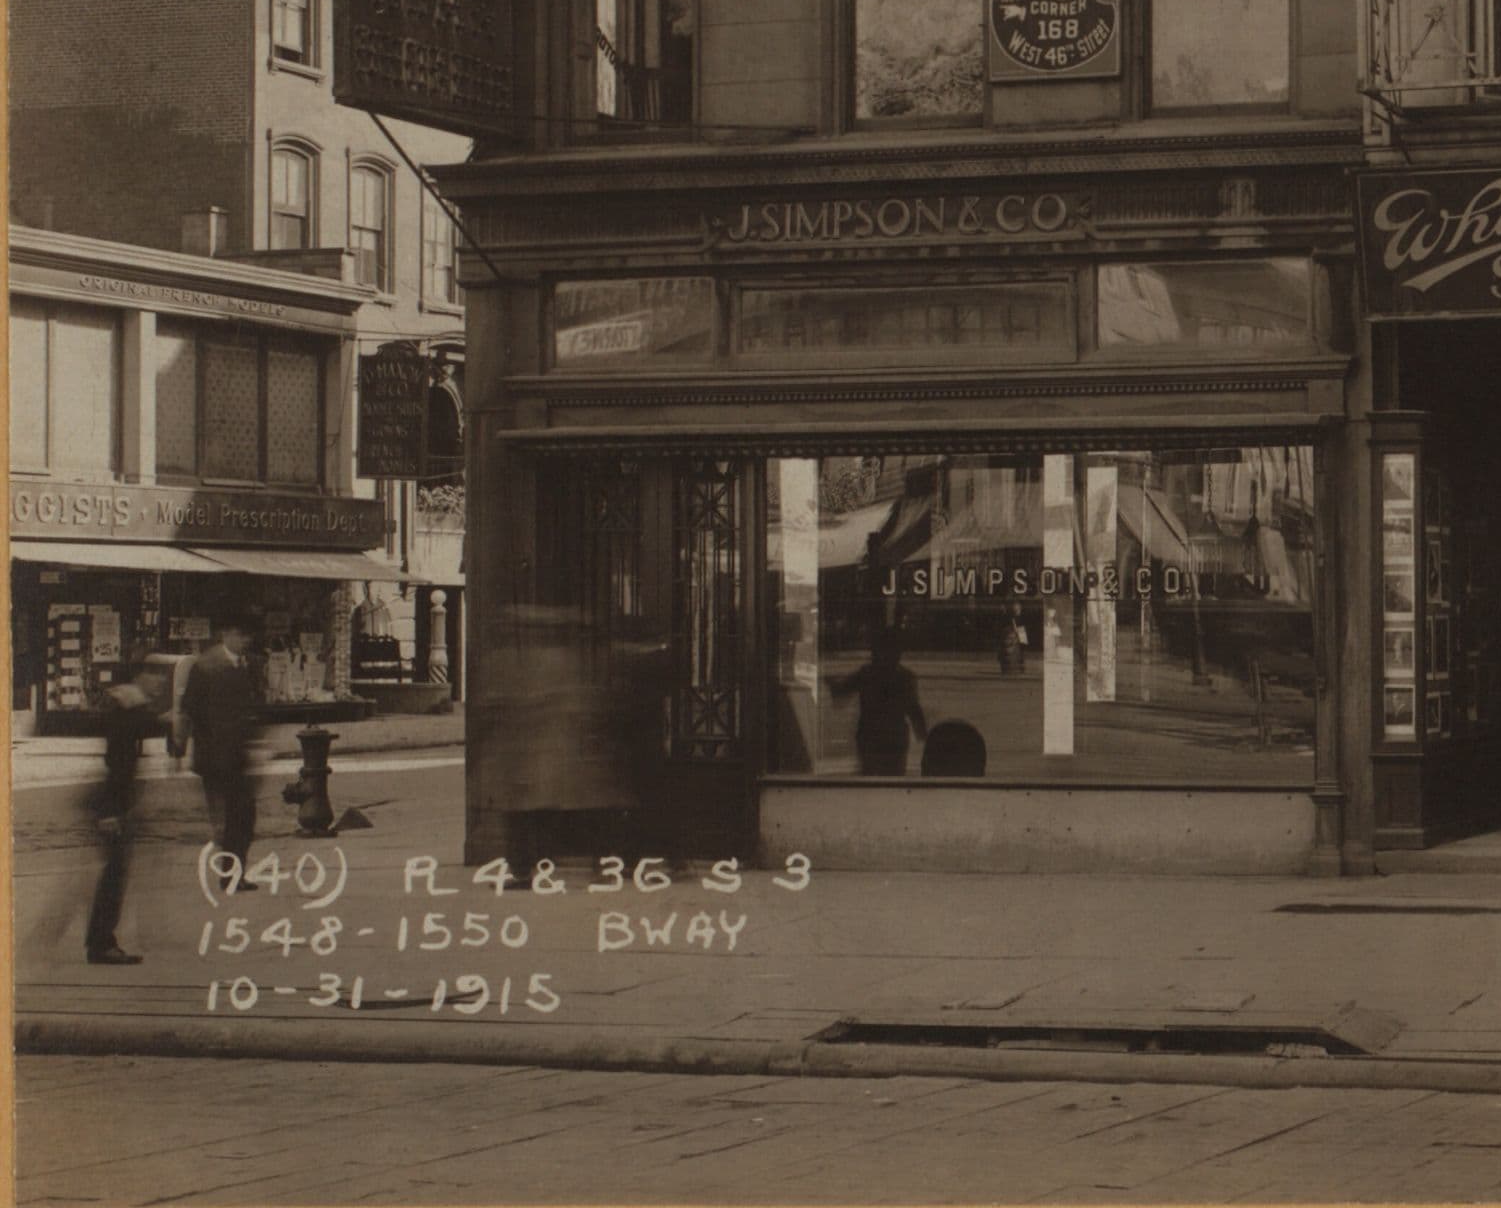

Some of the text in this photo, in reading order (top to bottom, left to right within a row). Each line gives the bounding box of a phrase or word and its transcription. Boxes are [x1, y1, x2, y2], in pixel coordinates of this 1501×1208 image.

[1008, 29, 1043, 65] WEST
[1037, 19, 1079, 41] 168
[957, 195, 986, 235] &
[79, 275, 156, 298] ORIGINAL
[160, 286, 222, 307] FRENCH
[10, 490, 132, 527] GGISTS
[155, 501, 211, 527] Model
[219, 503, 320, 535] Prescription
[1101, 568, 1120, 595] &
